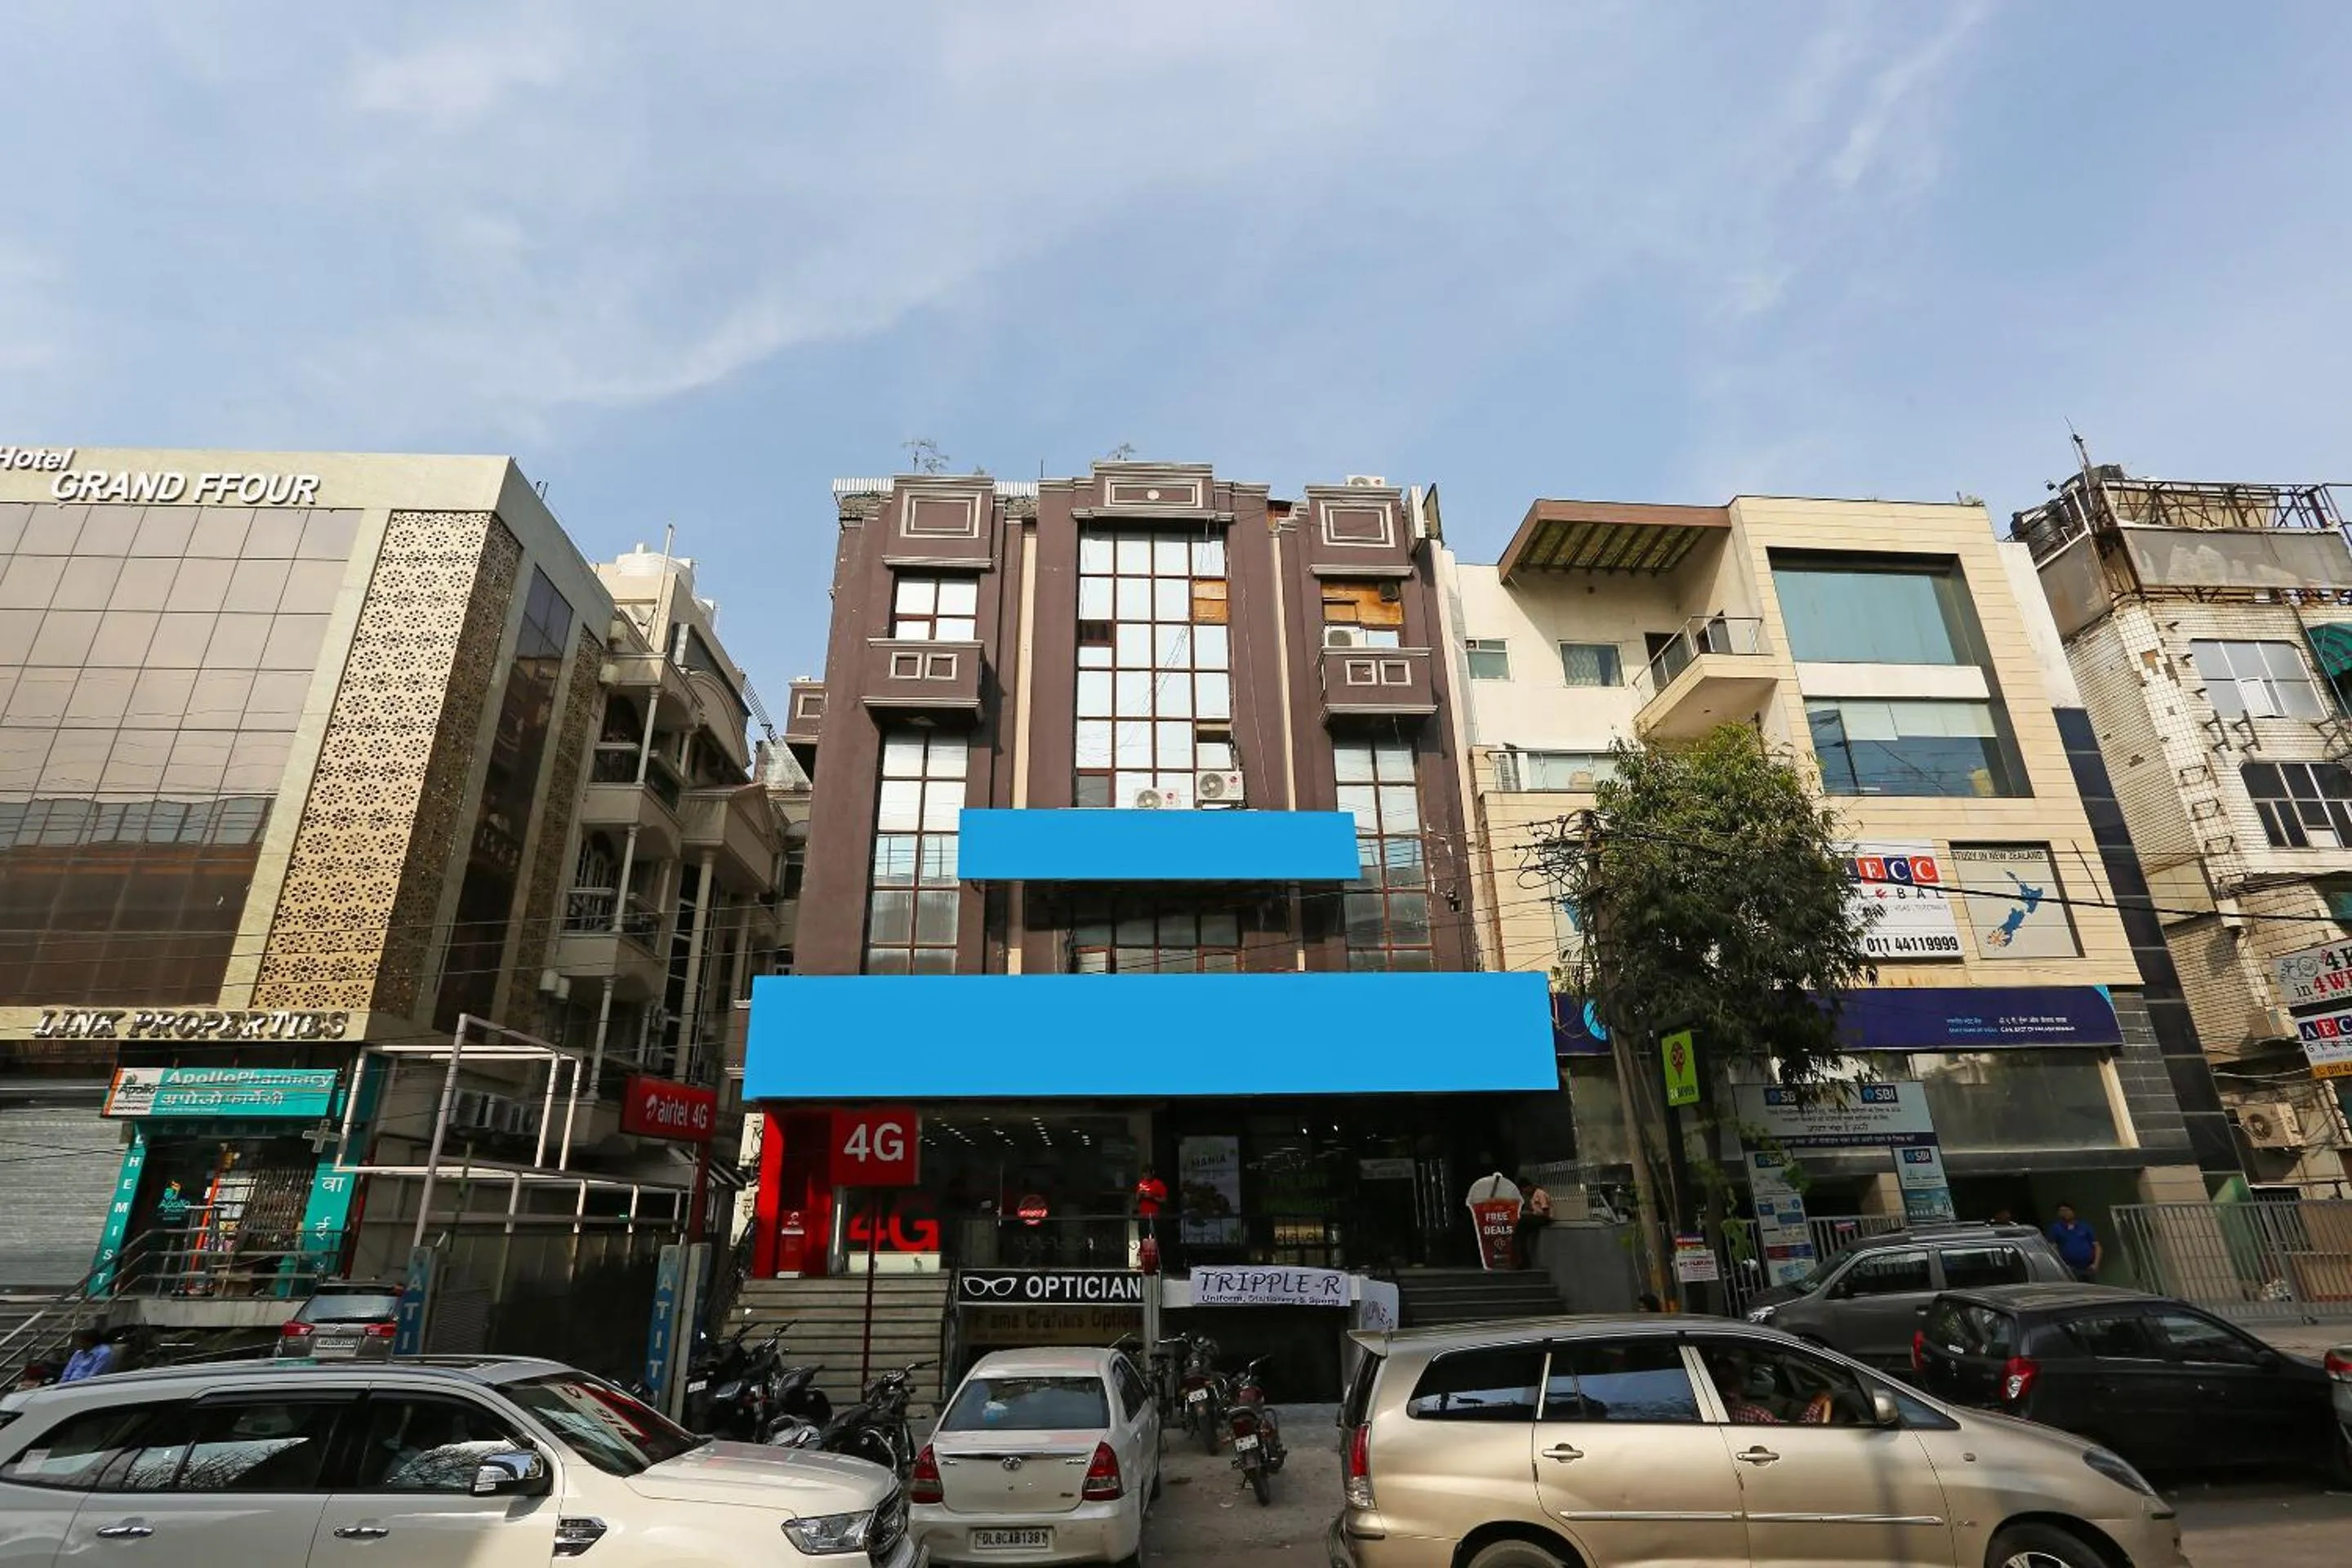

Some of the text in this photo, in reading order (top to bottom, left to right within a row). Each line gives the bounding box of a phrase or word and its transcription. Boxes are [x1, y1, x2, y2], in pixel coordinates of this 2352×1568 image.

[0, 446, 75, 470] Hotel
[51, 470, 320, 505] GRAND FFOUR
[1989, 851, 2006, 859] NEW
[1846, 860, 1935, 880] ECC
[1867, 937, 1958, 952] 011 44119999
[32, 1010, 350, 1039] LINK PROPERTIES
[118, 1083, 157, 1099] Apollo
[1780, 1092, 1797, 1102] SB
[1874, 1085, 1895, 1101] SBI
[657, 1096, 708, 1129] airtel 4G
[843, 1122, 904, 1162] 4G
[1486, 1211, 1509, 1221] FREE
[1484, 1226, 1513, 1235] DEALS
[1025, 1276, 1141, 1298] OPTICIAN
[1202, 1294, 1245, 1303] Uniform,
[1308, 1296, 1340, 1306] Sports
